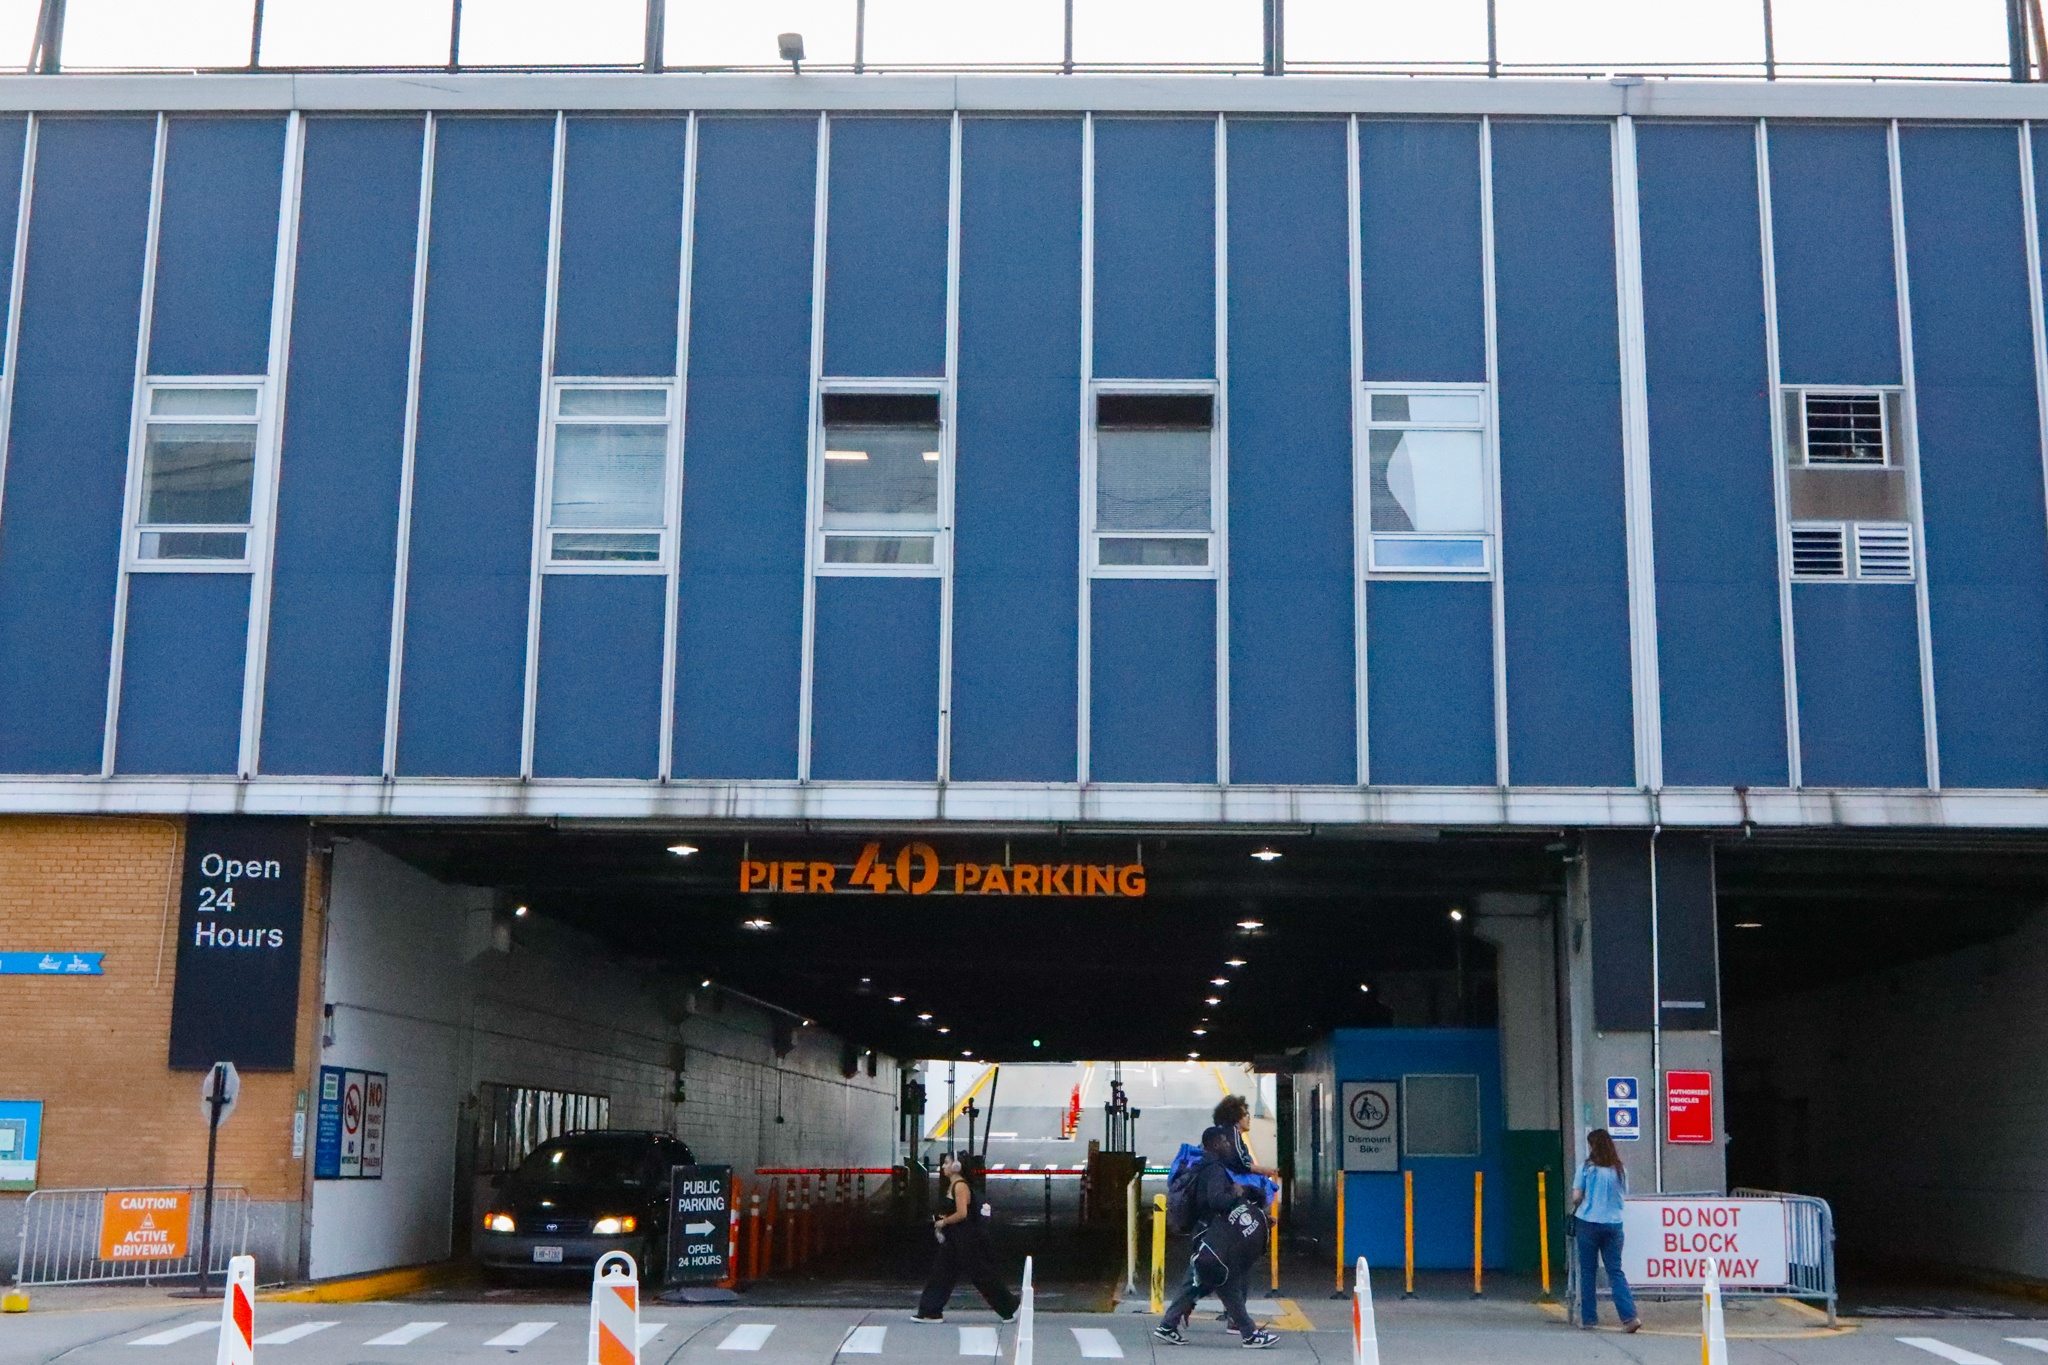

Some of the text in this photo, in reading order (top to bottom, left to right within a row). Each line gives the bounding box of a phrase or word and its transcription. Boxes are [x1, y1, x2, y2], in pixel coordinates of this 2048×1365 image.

[201, 854, 281, 883] Open
[740, 842, 1147, 897] PIER 40 PARKING
[198, 887, 235, 912] 24
[195, 922, 284, 948] Hours
[368, 1082, 383, 1108] NO
[1348, 1134, 1392, 1144] Dismount
[1360, 1145, 1380, 1154] Bike
[683, 1180, 720, 1195] PUBLIC
[121, 1197, 177, 1210] CAUTION!
[678, 1197, 725, 1212] PARKING
[1662, 1208, 1741, 1227] DO NOT
[125, 1230, 168, 1243] ACTIVE
[1664, 1232, 1740, 1254] BLOCK
[113, 1243, 175, 1257] DRIVEWAY
[687, 1243, 713, 1255] OPEN
[678, 1255, 722, 1267] 24 HOURS
[1647, 1259, 1760, 1278] DRIVEWAY
